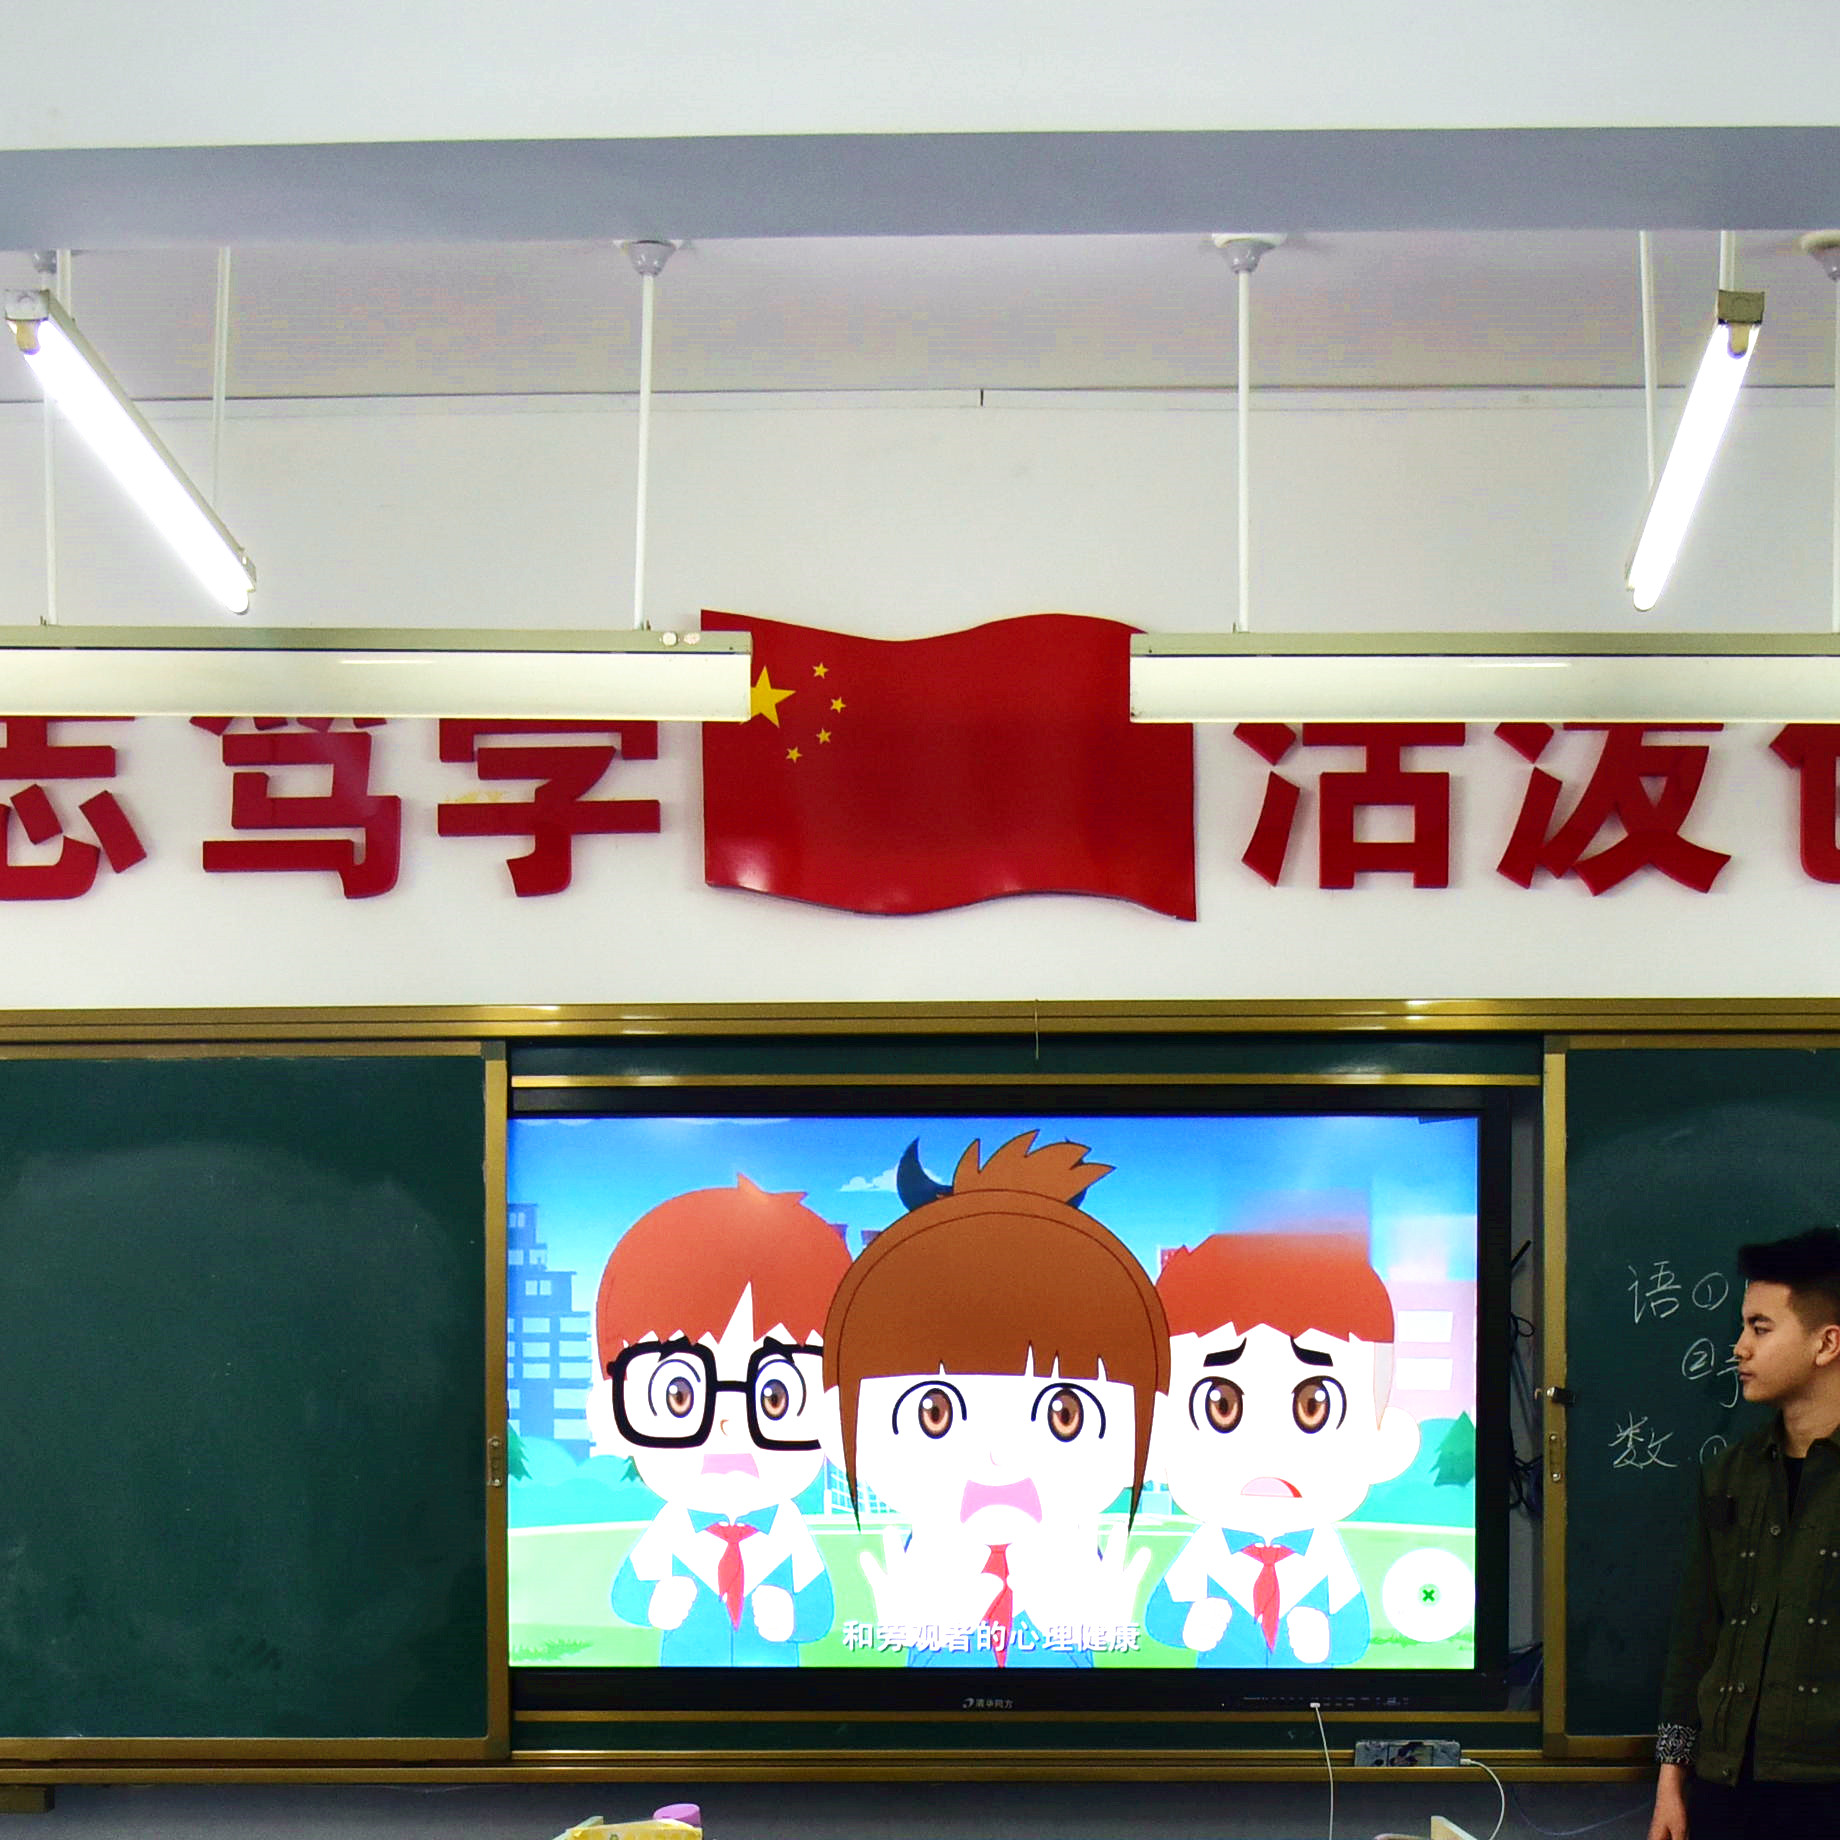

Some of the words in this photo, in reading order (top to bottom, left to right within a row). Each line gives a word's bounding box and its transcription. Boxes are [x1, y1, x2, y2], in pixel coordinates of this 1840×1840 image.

[843, 1619, 1140, 1654] 和旁观者的心理健康
